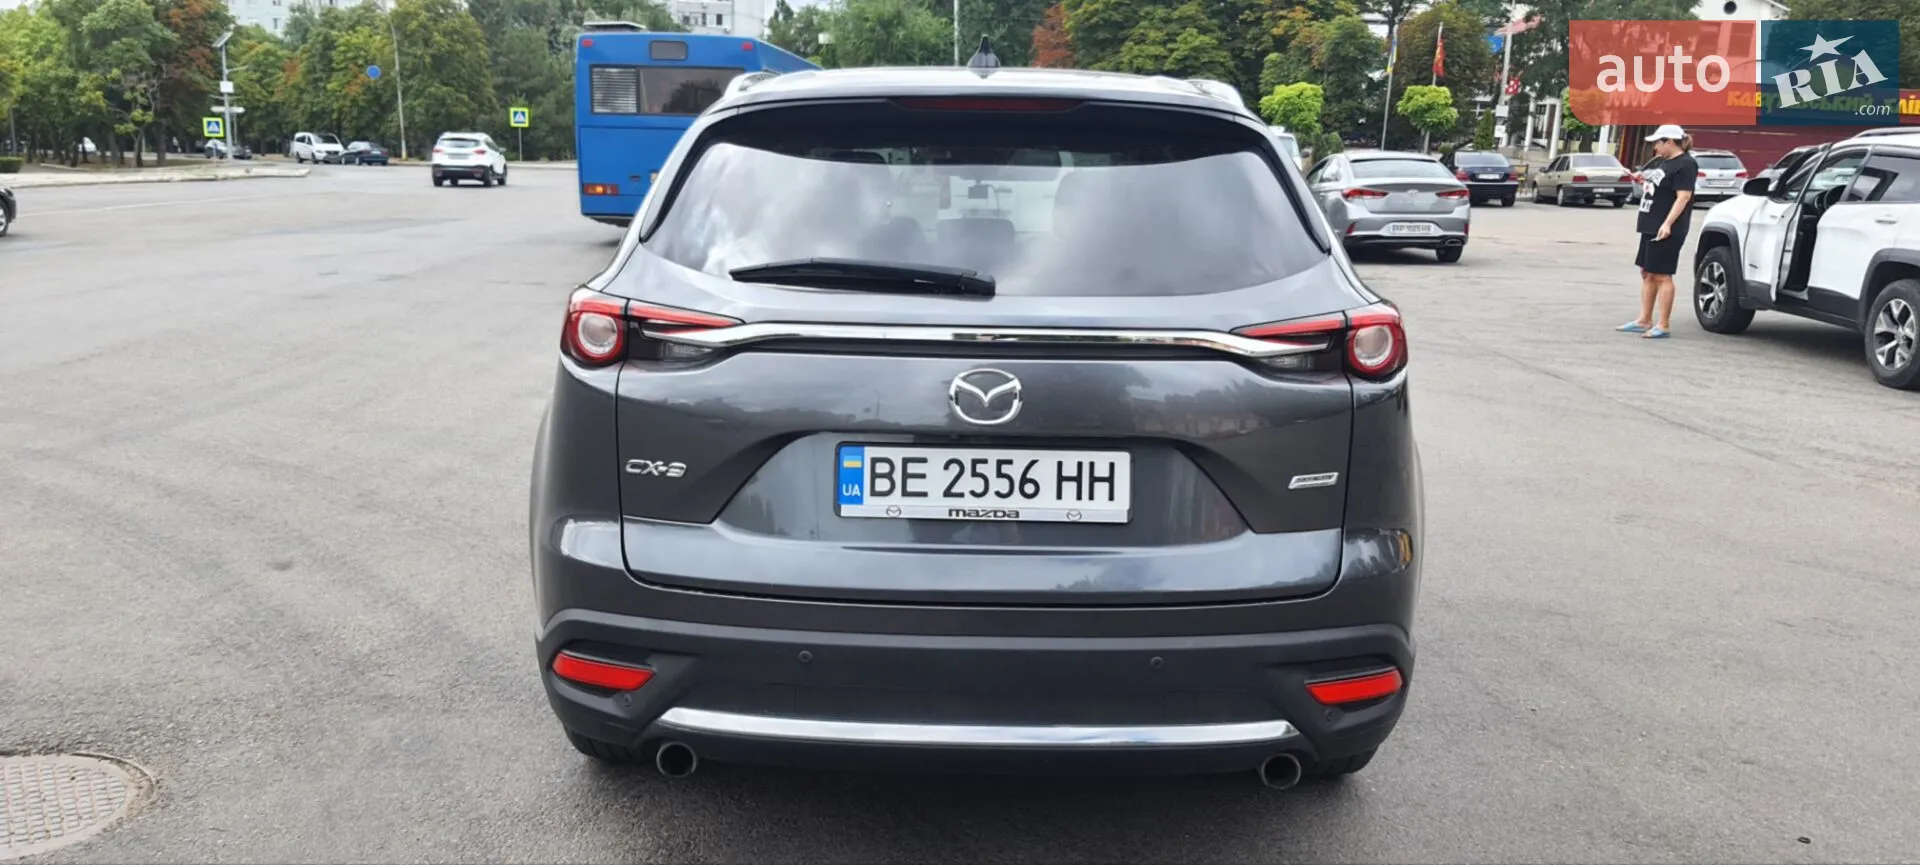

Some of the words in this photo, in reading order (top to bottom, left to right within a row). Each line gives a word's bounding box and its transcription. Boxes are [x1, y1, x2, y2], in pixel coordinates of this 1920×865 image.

[842, 484, 861, 497] UA
[869, 457, 928, 498] BE
[942, 458, 1041, 500] 2556
[1056, 460, 1115, 501] HH
